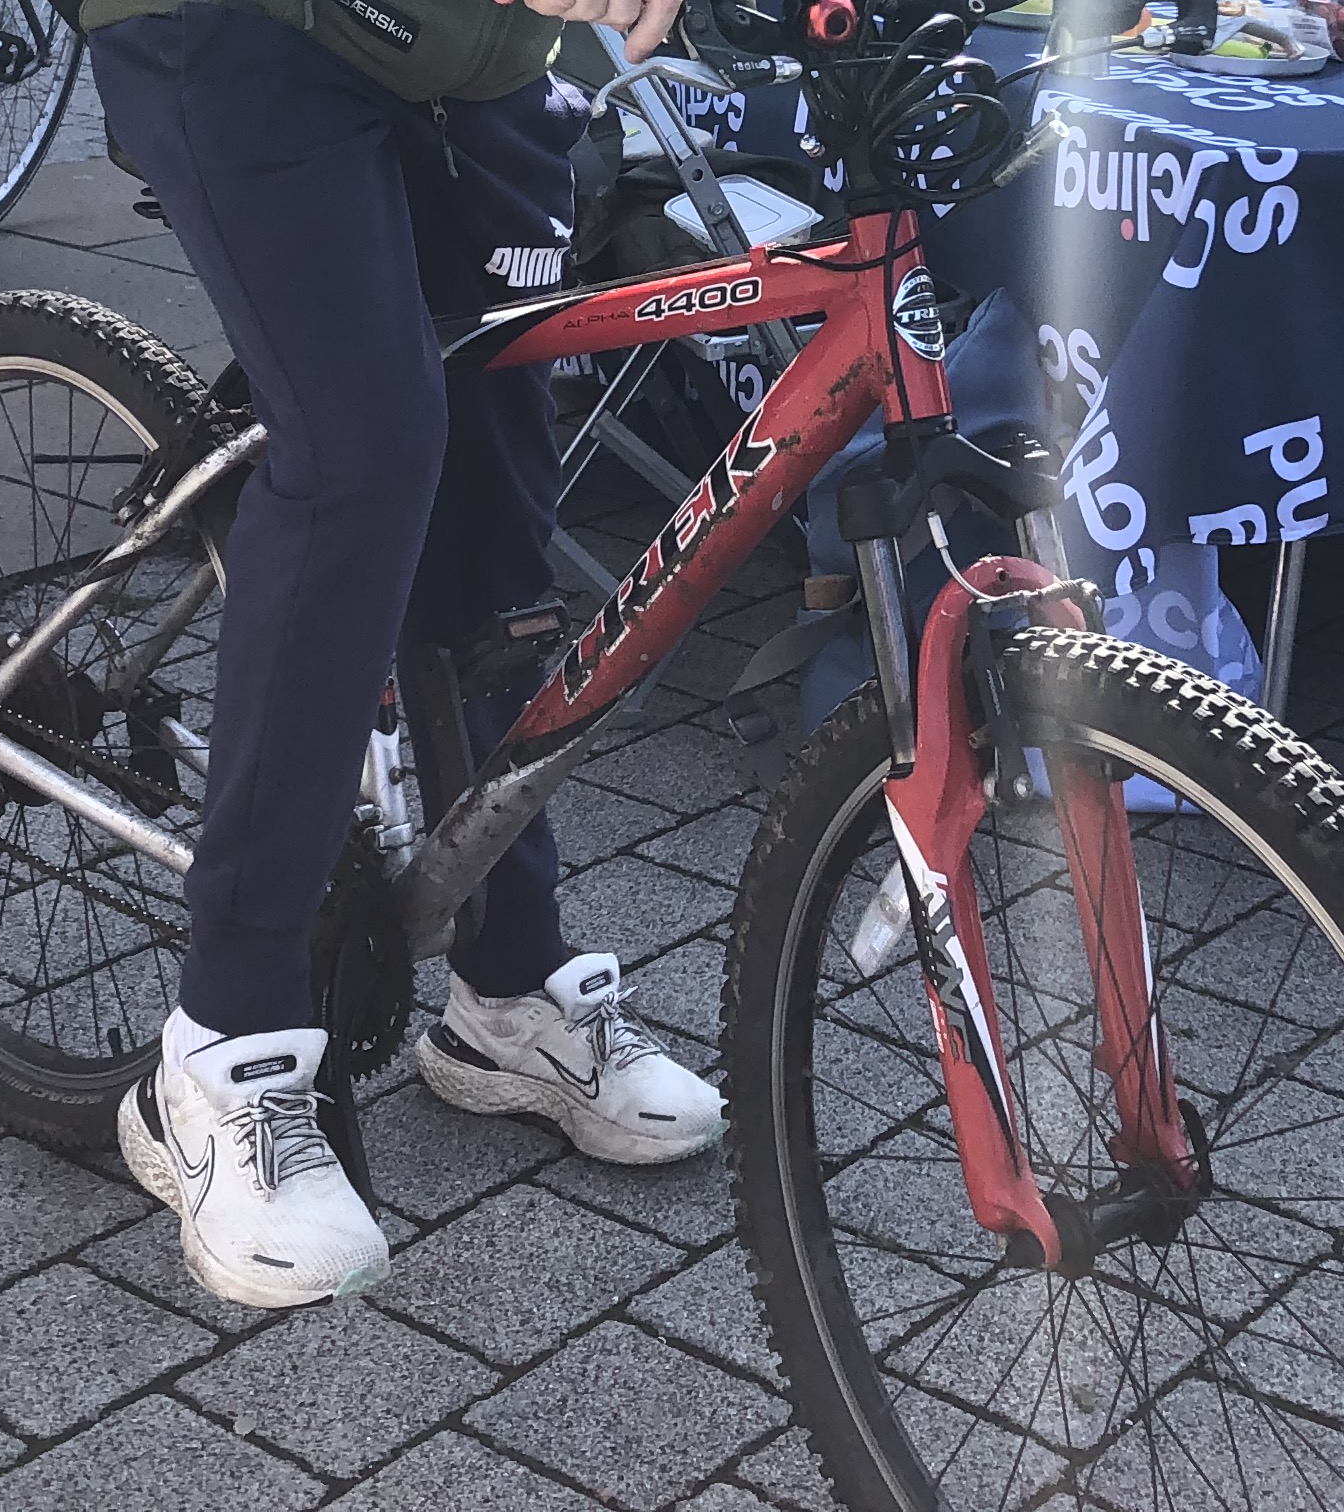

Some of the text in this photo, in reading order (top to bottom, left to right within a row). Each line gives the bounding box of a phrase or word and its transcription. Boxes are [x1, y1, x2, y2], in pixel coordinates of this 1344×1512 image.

[484, 246, 571, 288] PUMA
[634, 276, 762, 322] 4400
[896, 307, 940, 324] TRE
[544, 406, 777, 706] TREK
